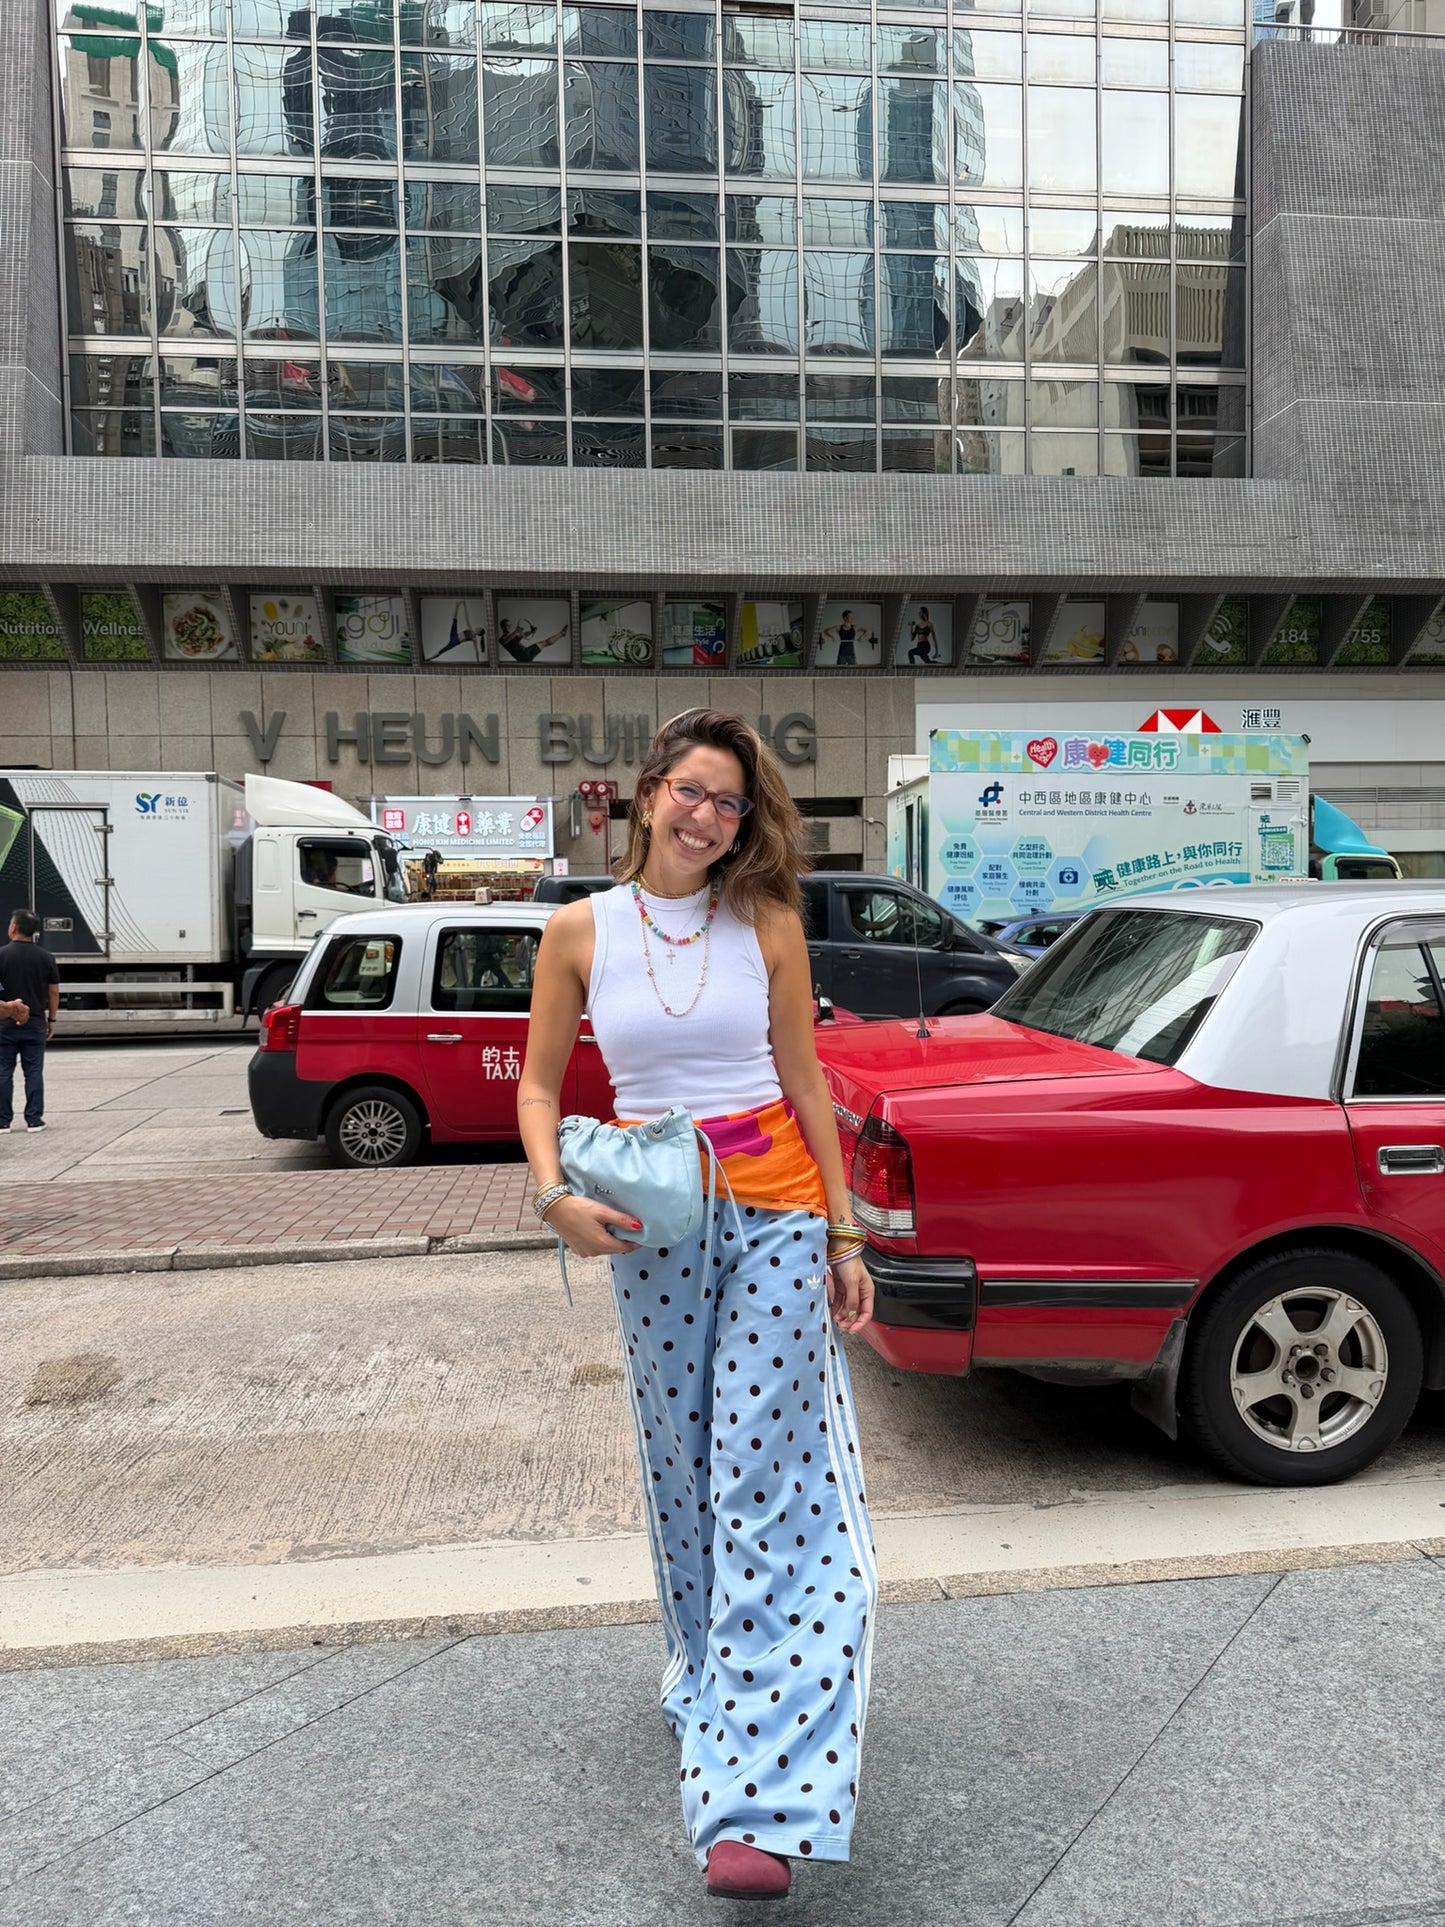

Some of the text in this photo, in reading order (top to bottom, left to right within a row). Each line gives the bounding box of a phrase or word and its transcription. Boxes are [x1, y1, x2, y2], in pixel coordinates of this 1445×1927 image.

[83, 622, 144, 635] Wellnes
[1272, 629, 1309, 643] 184
[1346, 629, 1381, 643] 755
[240, 710, 286, 763] V
[326, 711, 499, 765] HEUN
[1018, 791, 1152, 806] 中西區地區康健中心
[1018, 809, 1152, 817] Central and Western District Health Centre
[412, 812, 455, 836] 康健
[474, 811, 514, 836] 藥業
[412, 838, 434, 847] HONG
[435, 838, 450, 847] KIN
[450, 838, 485, 847] MEDICINE
[486, 838, 515, 847] LIMITED
[1123, 872, 1156, 887] Together
[1169, 866, 1182, 874] the
[1184, 862, 1203, 871] Road
[1215, 857, 1241, 865] Health
[482, 1046, 520, 1063] 的士
[482, 1063, 520, 1080] TAXI
